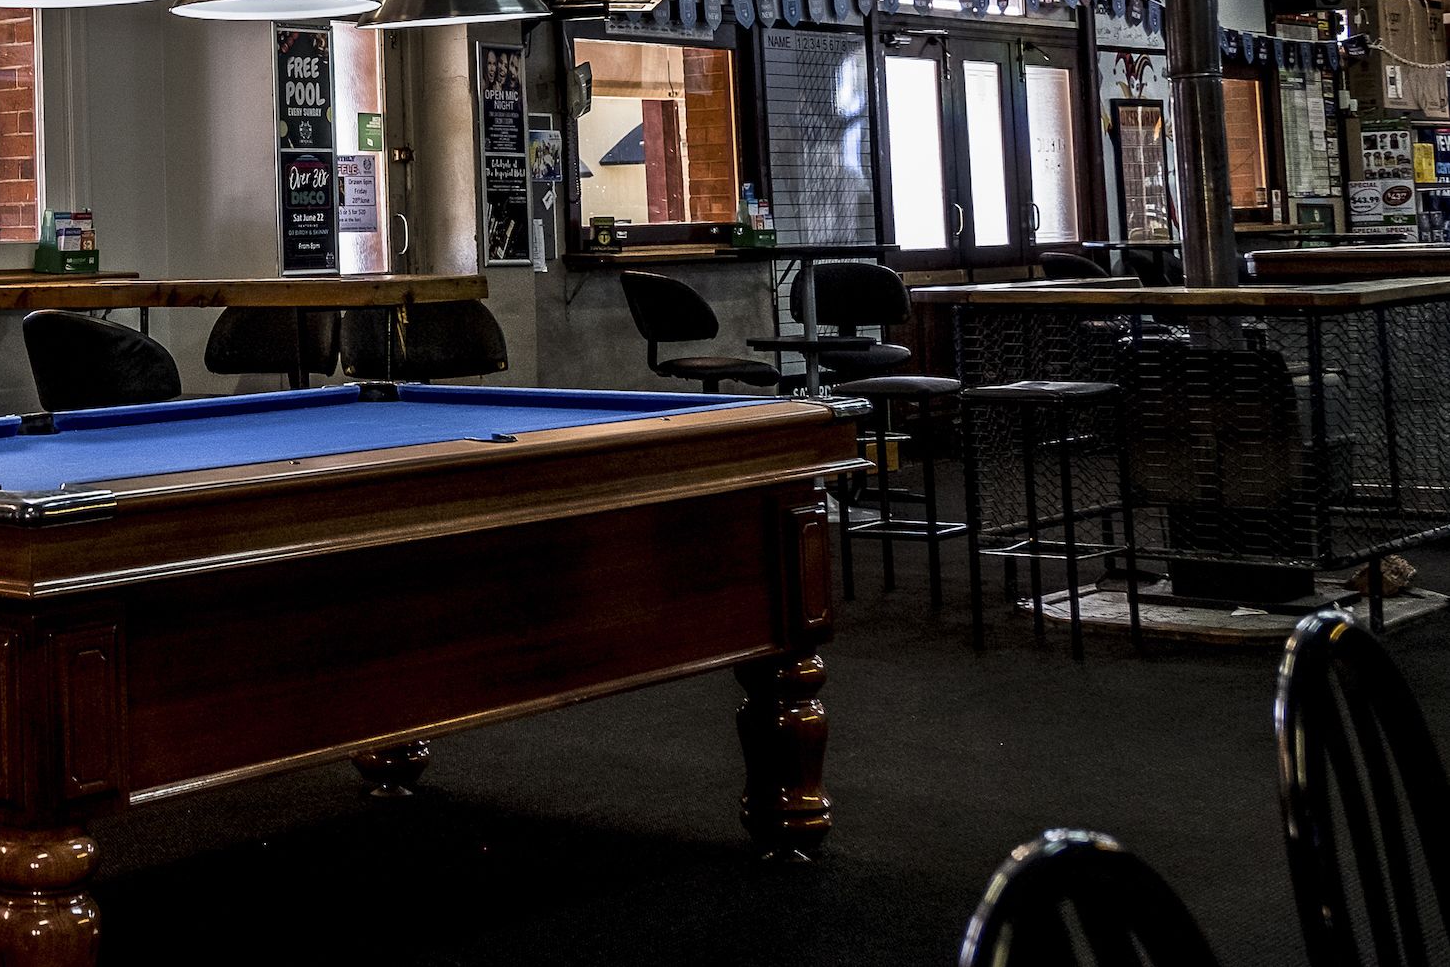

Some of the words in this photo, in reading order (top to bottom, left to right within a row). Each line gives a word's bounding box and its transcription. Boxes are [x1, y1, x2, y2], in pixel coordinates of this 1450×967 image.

[768, 35, 791, 48] NAME
[287, 56, 319, 78] FREE
[286, 81, 325, 106] POOL
[485, 90, 504, 100] OPEN
[505, 90, 518, 101] MIC
[288, 107, 302, 116] EVERY
[303, 108, 321, 116] SUNDAY
[494, 101, 514, 110] NIGHT
[290, 166, 311, 190] Over
[313, 168, 330, 188] 30s
[291, 190, 326, 205] DISCO
[1351, 196, 1379, 204] $43.99
[293, 214, 302, 222] Sat
[303, 214, 316, 222] June
[317, 213, 324, 221] 22
